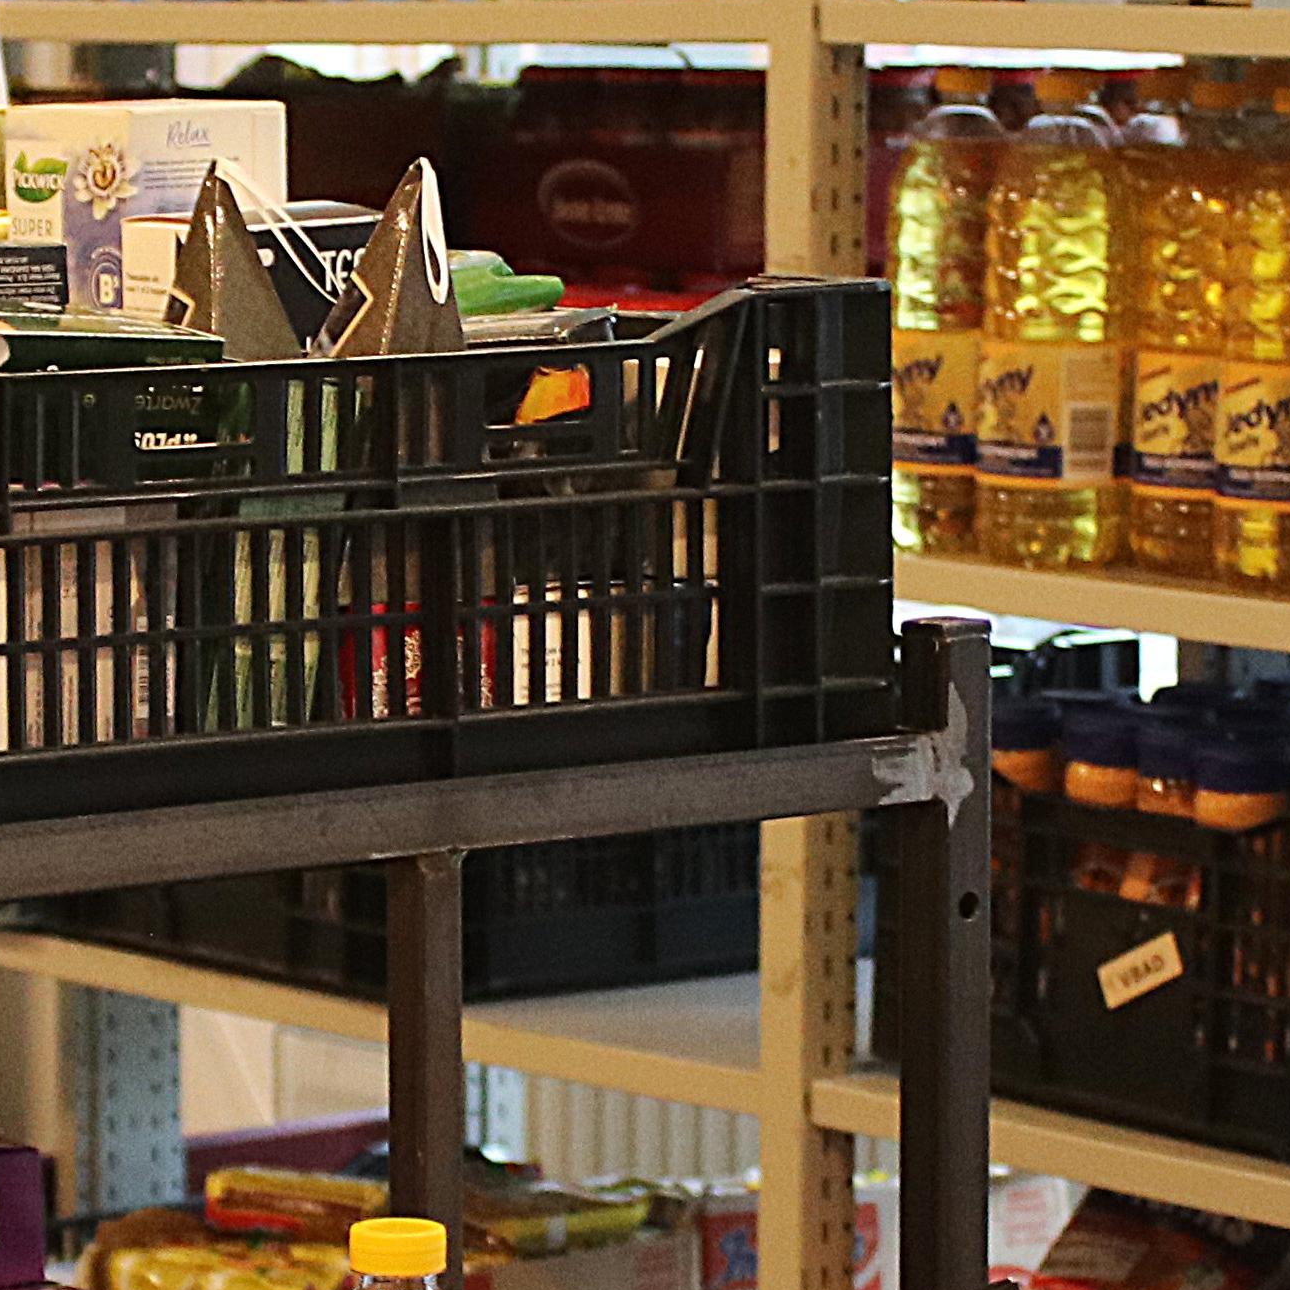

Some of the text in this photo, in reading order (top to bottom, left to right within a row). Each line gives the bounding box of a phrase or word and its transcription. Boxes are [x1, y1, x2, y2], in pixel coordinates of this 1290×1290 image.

[166, 120, 210, 148] Relax
[12, 169, 66, 191] PICKWICK
[11, 217, 53, 238] SUPER
